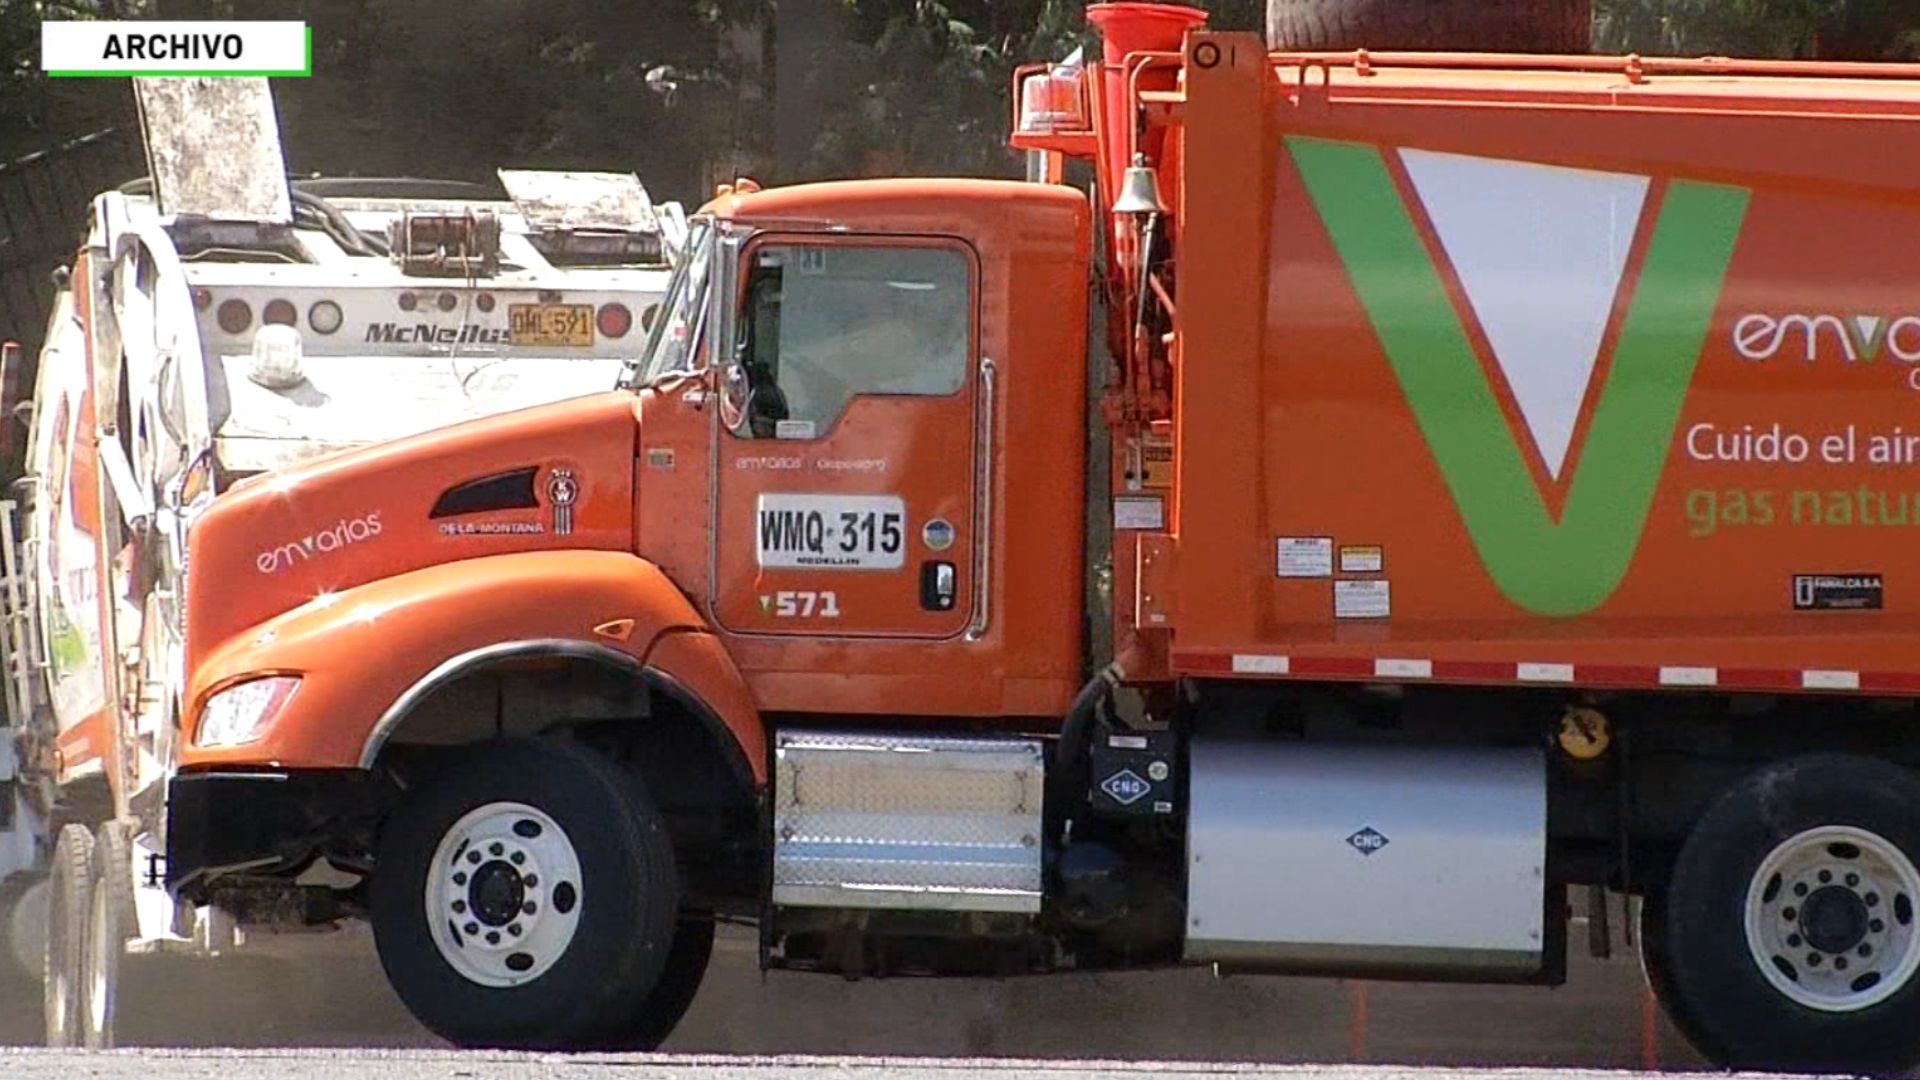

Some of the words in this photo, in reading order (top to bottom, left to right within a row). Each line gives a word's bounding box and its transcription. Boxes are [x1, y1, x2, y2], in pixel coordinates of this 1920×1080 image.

[1686, 422, 1808, 461] Cuido
[1821, 424, 1856, 463] el
[1685, 489, 1775, 539] gas
[256, 512, 382, 574] emvarias
[776, 591, 840, 617] 571
[1112, 780, 1140, 794] CNG
[1353, 834, 1382, 848] CNG
